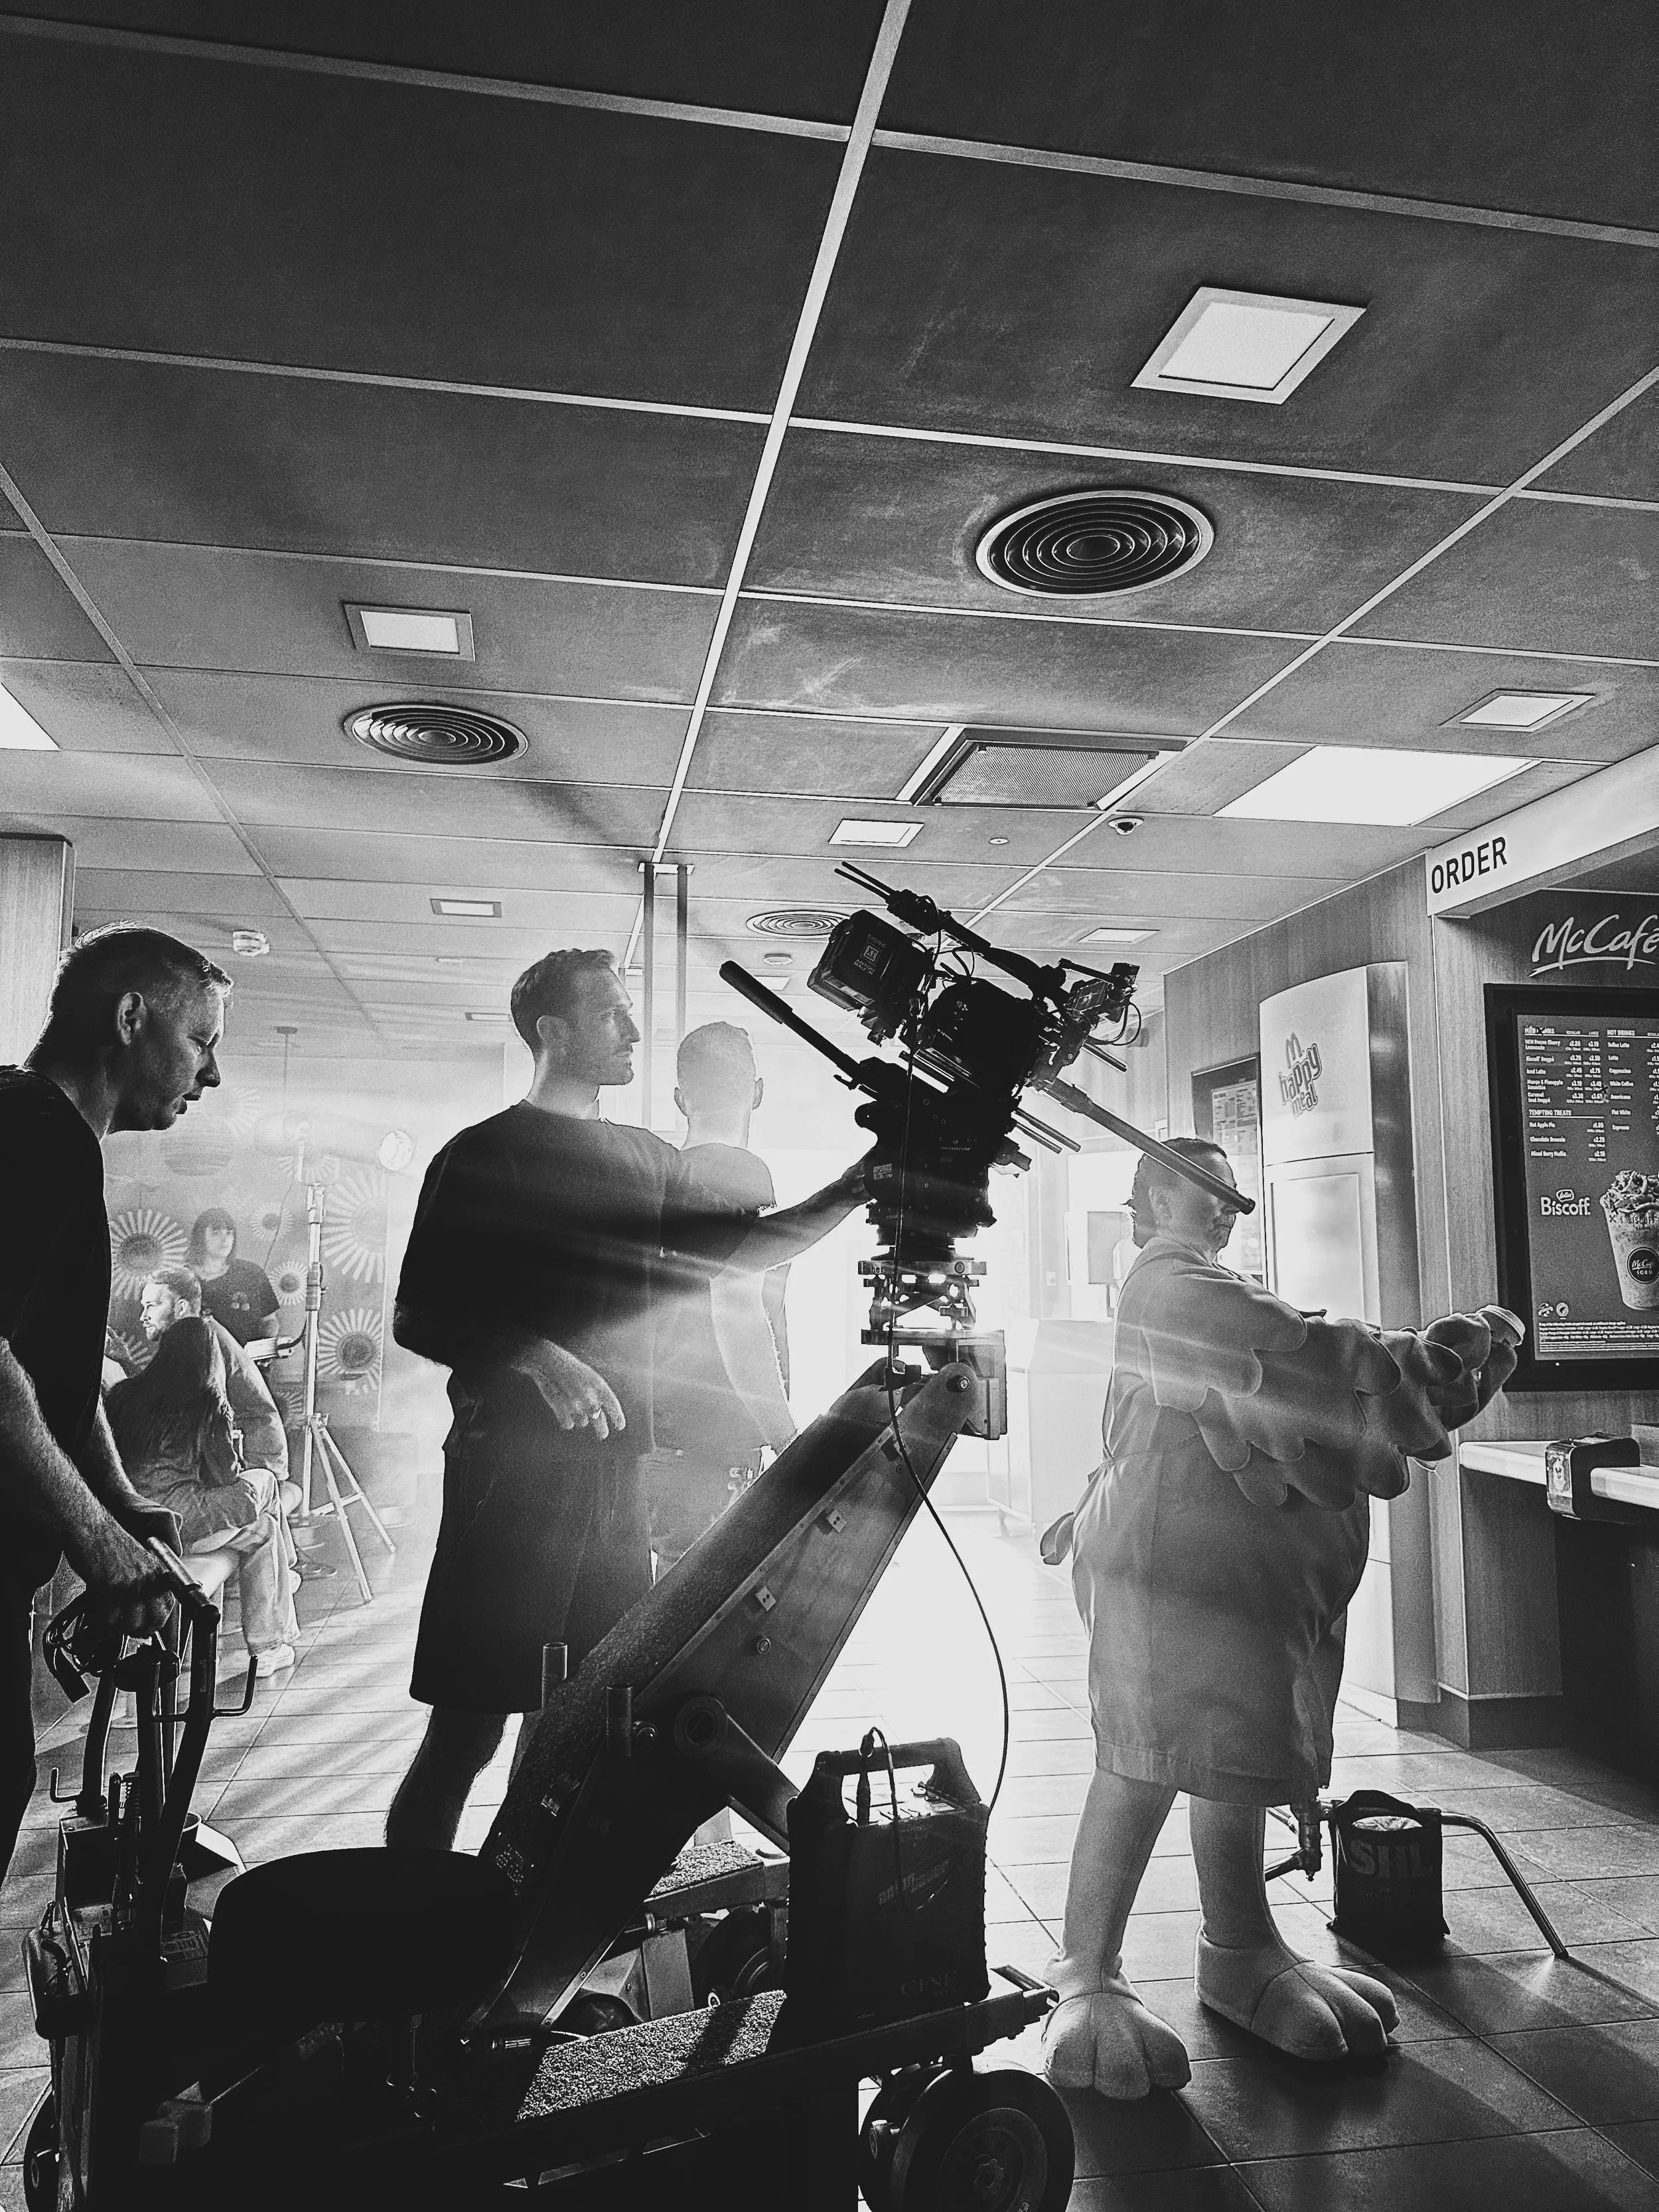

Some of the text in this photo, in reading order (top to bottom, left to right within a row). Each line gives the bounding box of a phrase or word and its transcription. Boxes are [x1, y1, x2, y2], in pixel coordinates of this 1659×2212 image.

[1431, 836, 1508, 894] ORDER
[1279, 1043, 1321, 1105] happy
[1291, 1081, 1318, 1117] meal
[1540, 1197, 1591, 1216] Biscoff
